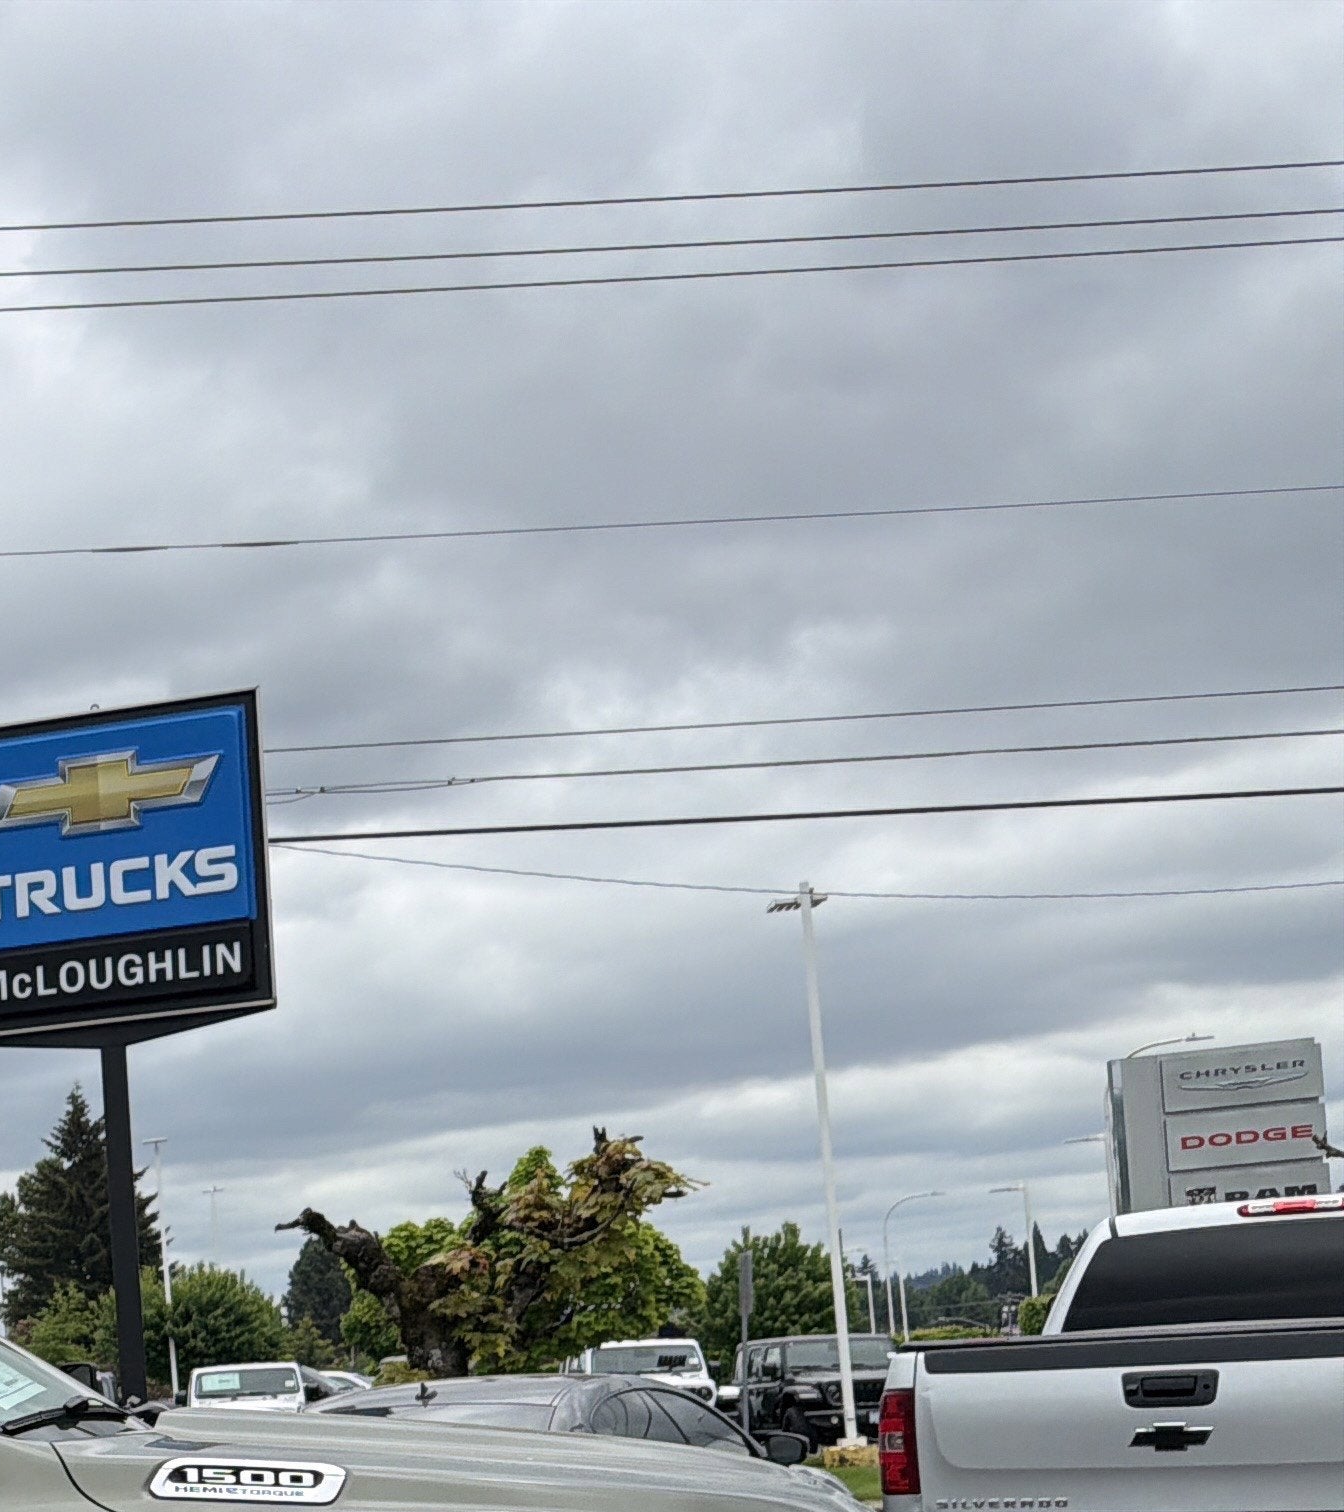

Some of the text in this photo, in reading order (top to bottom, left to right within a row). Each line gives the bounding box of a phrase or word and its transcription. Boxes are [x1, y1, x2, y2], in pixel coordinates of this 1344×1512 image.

[1179, 1059, 1305, 1081] CHRYSLER
[1180, 1124, 1313, 1151] DODGE
[180, 1467, 315, 1487] 1500
[936, 1497, 1069, 1510] SILVERADO
